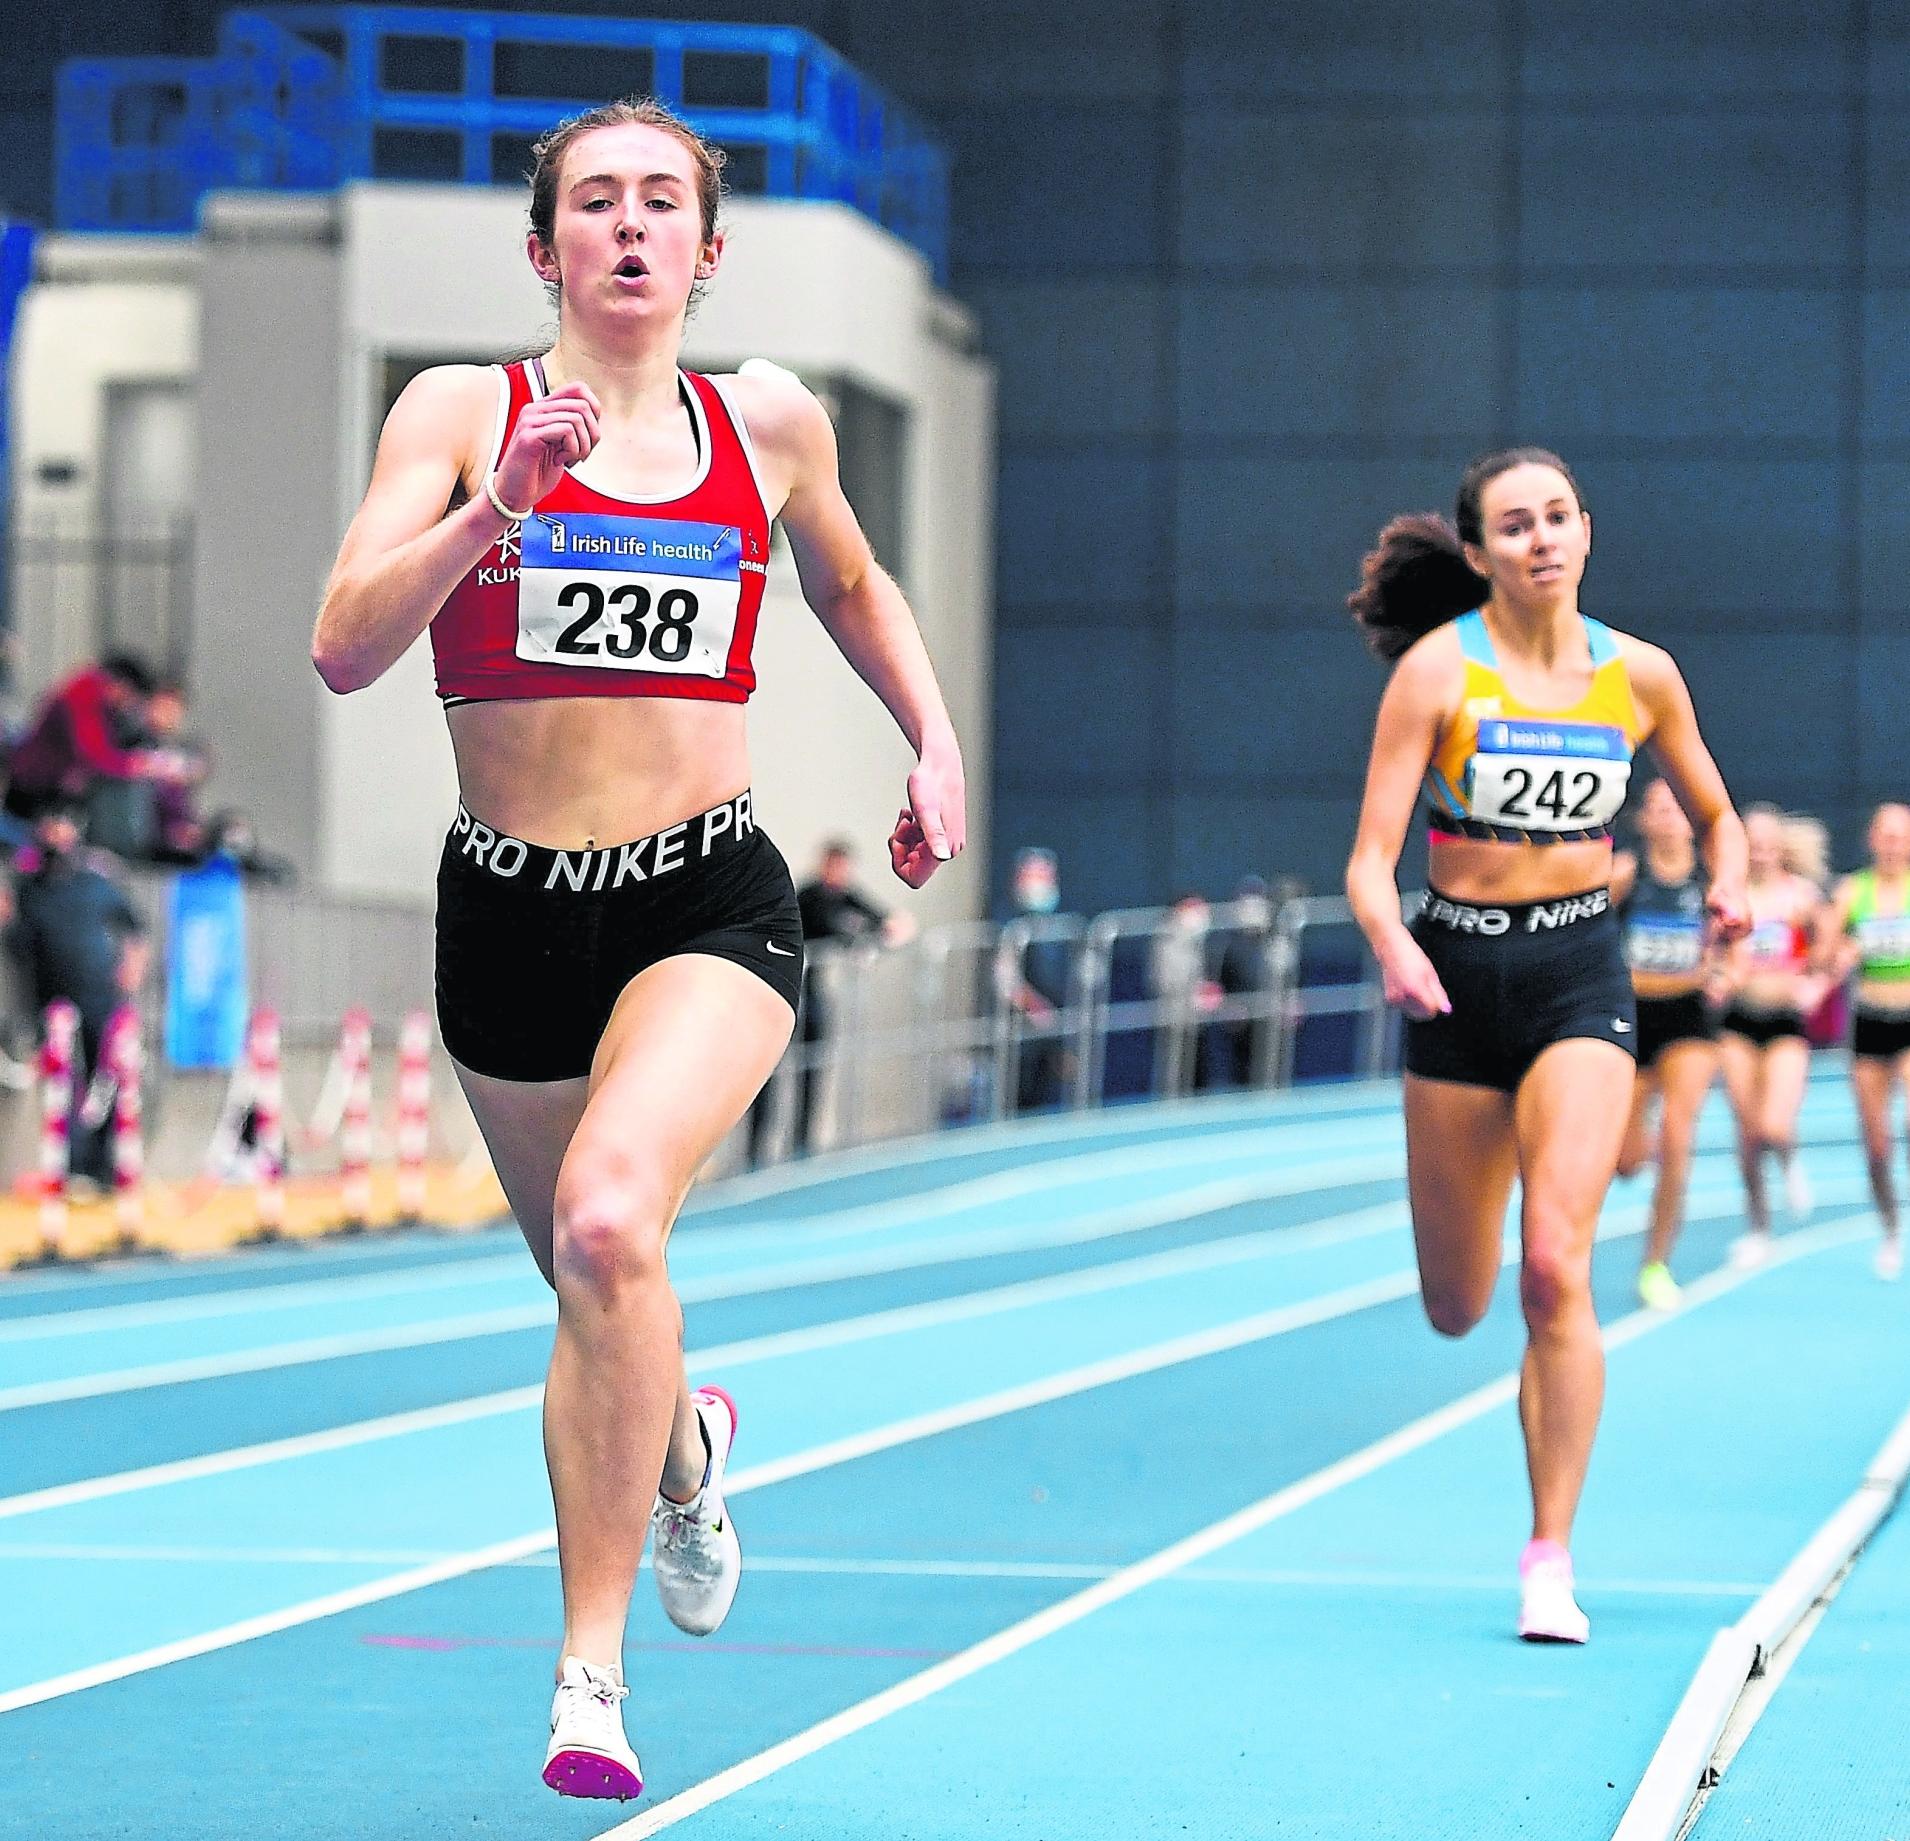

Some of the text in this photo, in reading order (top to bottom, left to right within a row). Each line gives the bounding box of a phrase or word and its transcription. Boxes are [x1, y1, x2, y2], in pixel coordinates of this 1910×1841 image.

[572, 534, 713, 562] Irish Life health
[555, 582, 699, 662] 238
[1499, 768, 1602, 818] 242
[453, 803, 528, 877] PRO
[544, 822, 688, 891] NIKE
[1429, 899, 1511, 936] PRO
[1524, 888, 1609, 934] NIKE
